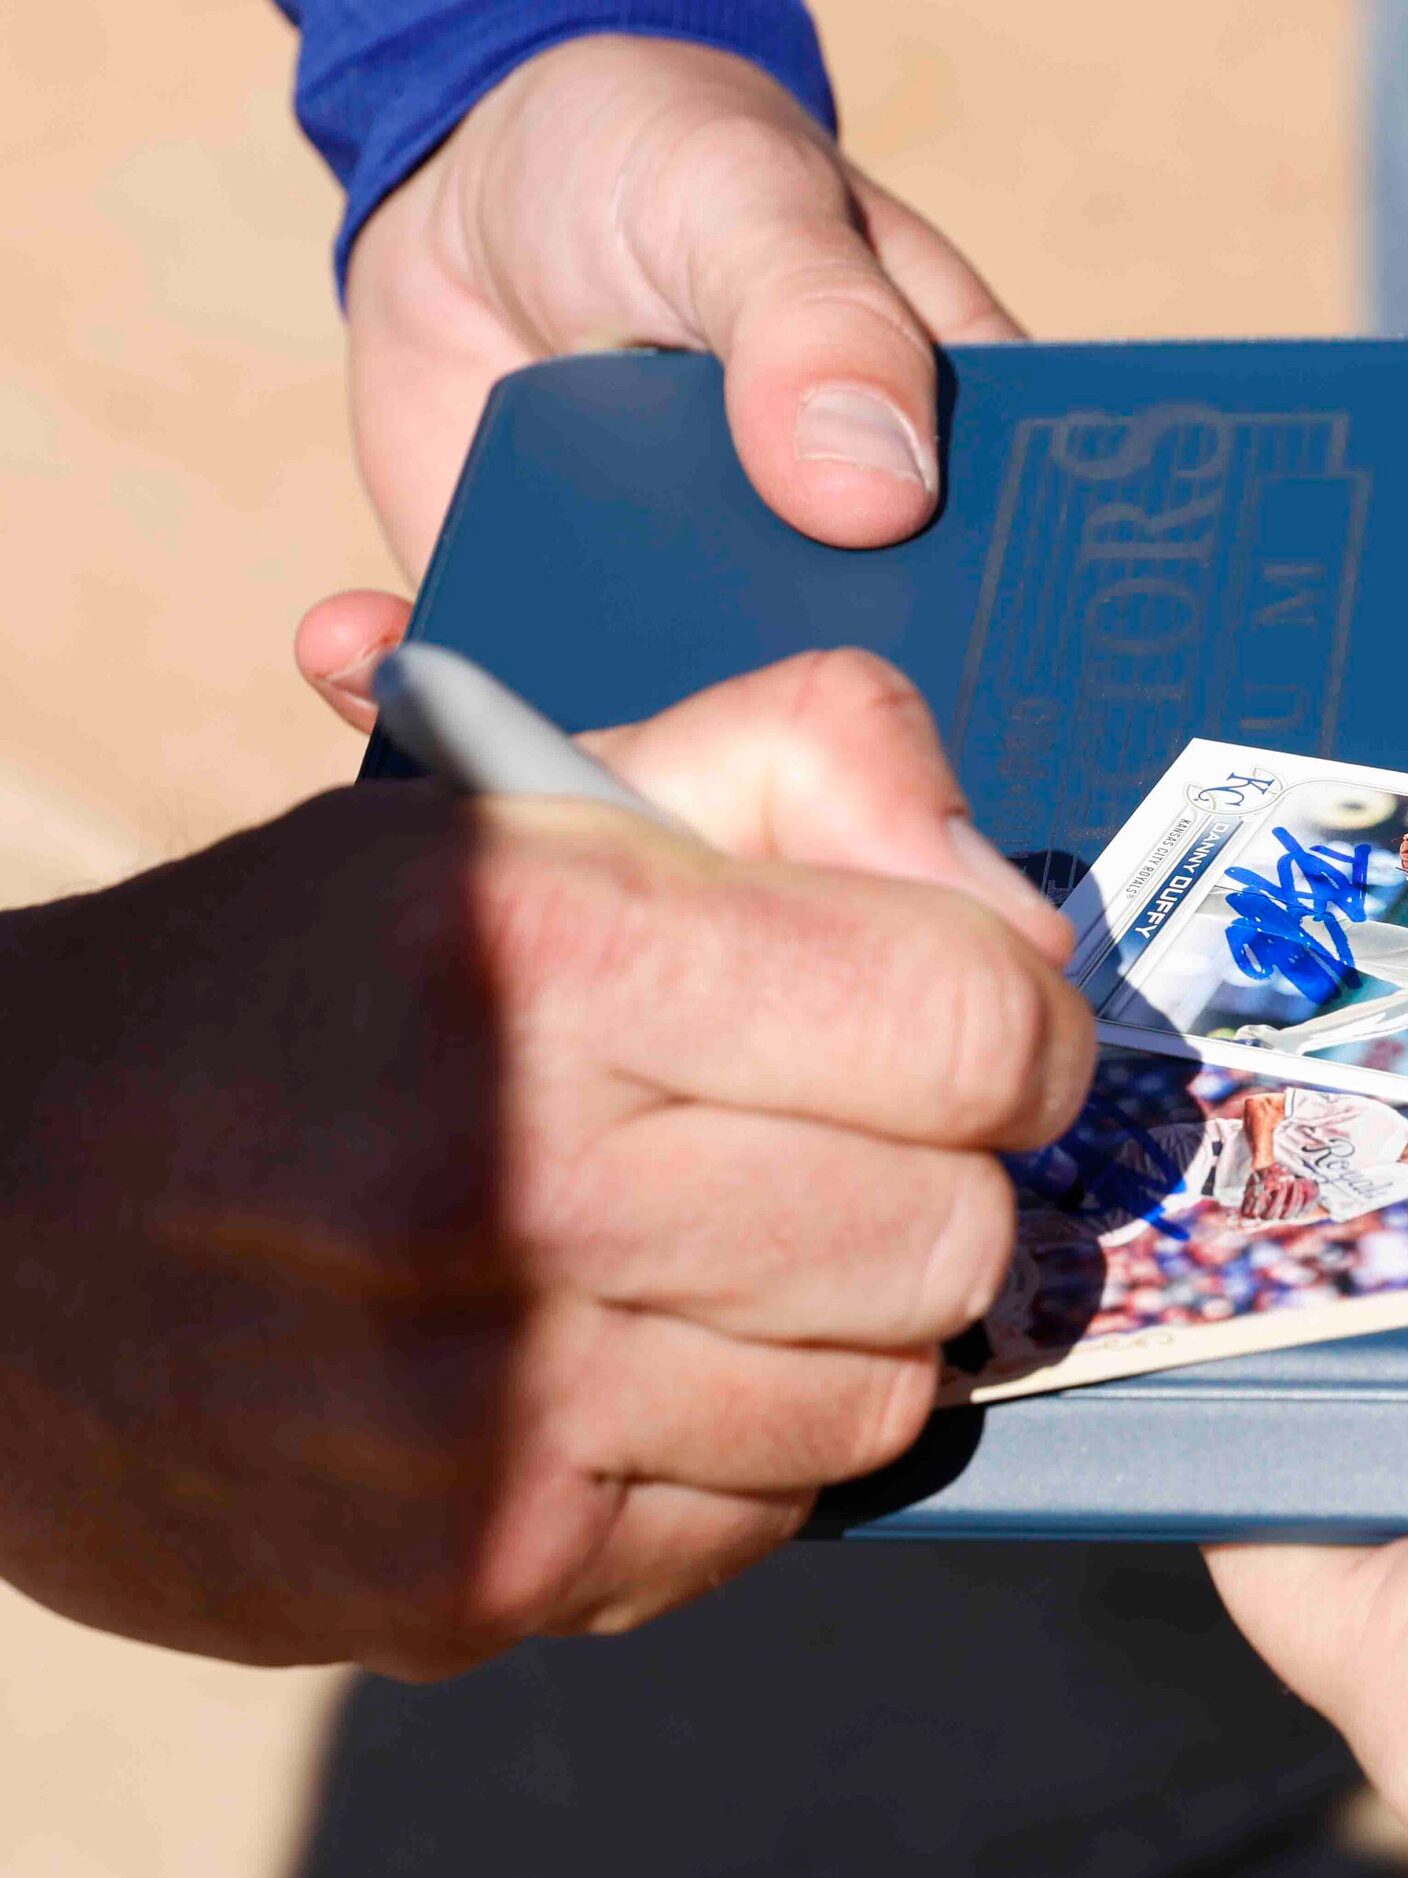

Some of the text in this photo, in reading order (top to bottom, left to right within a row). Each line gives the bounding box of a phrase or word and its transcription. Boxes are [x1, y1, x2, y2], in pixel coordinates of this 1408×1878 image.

[1193, 771, 1276, 807] KC
[1127, 818, 1193, 898] KANSAS CITY ROYALS
[1135, 821, 1232, 939] DANNY DUFFY
